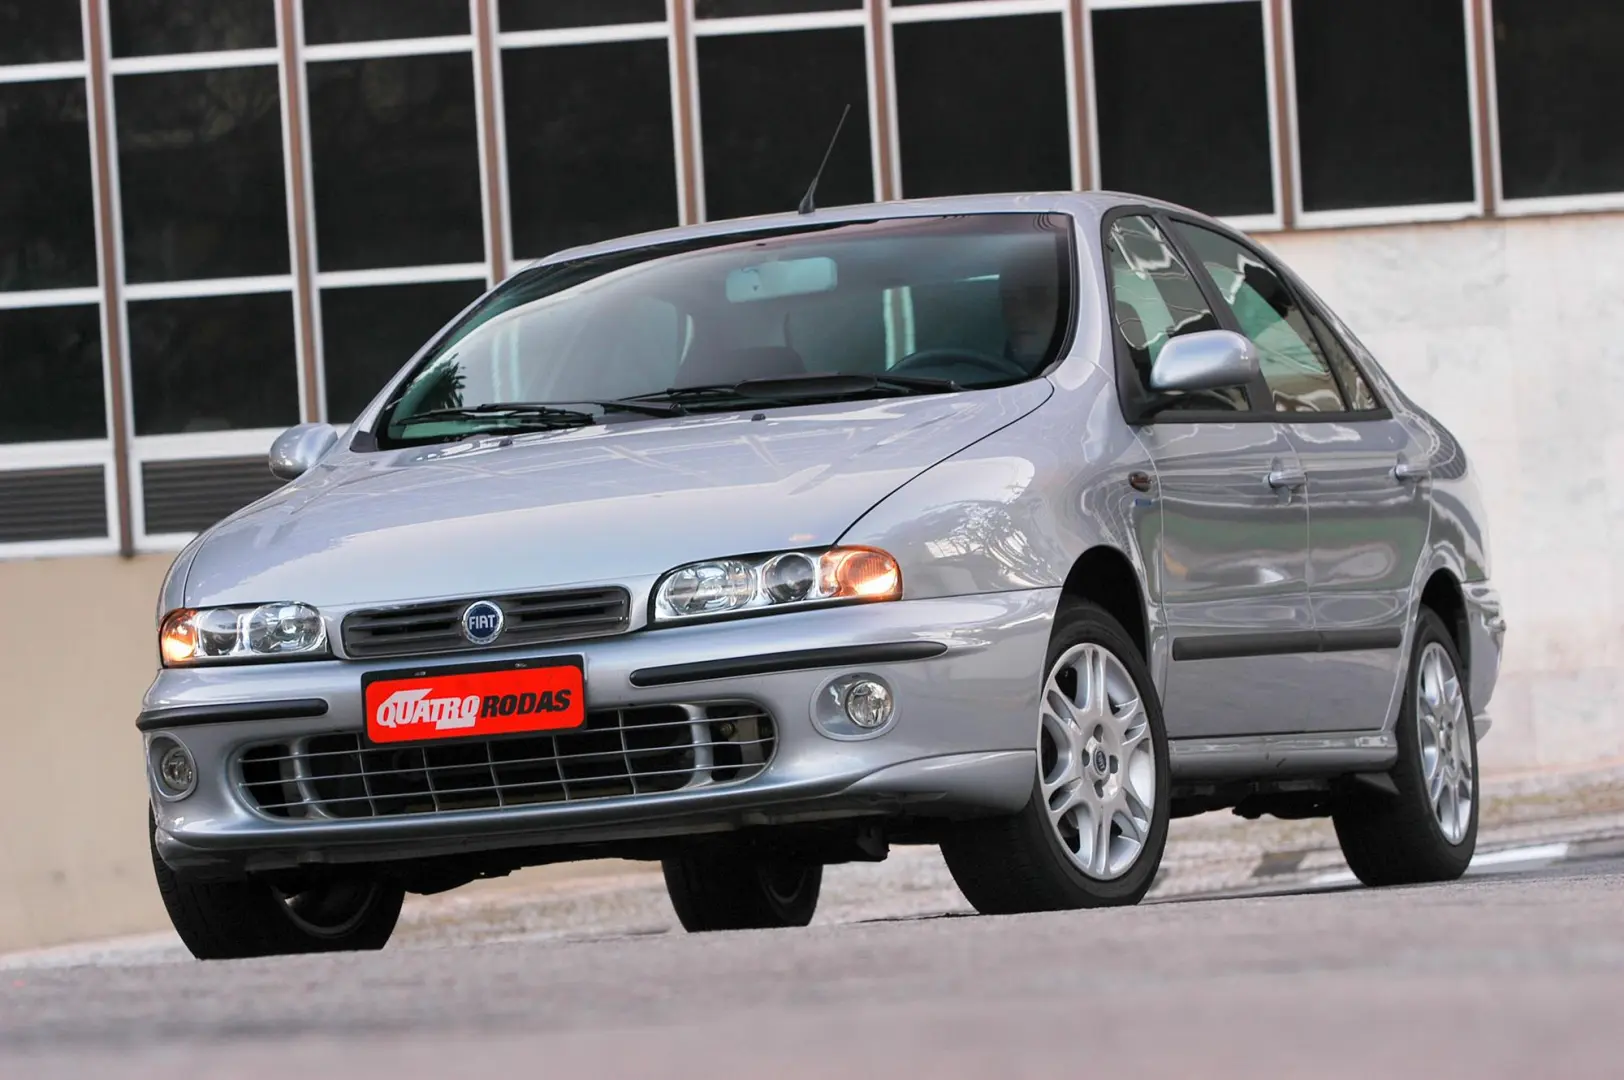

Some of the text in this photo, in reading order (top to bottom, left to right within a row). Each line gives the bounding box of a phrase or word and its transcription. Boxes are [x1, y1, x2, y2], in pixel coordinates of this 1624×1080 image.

[468, 614, 496, 630] FIAT
[376, 688, 572, 730] QUATRO RODAS
